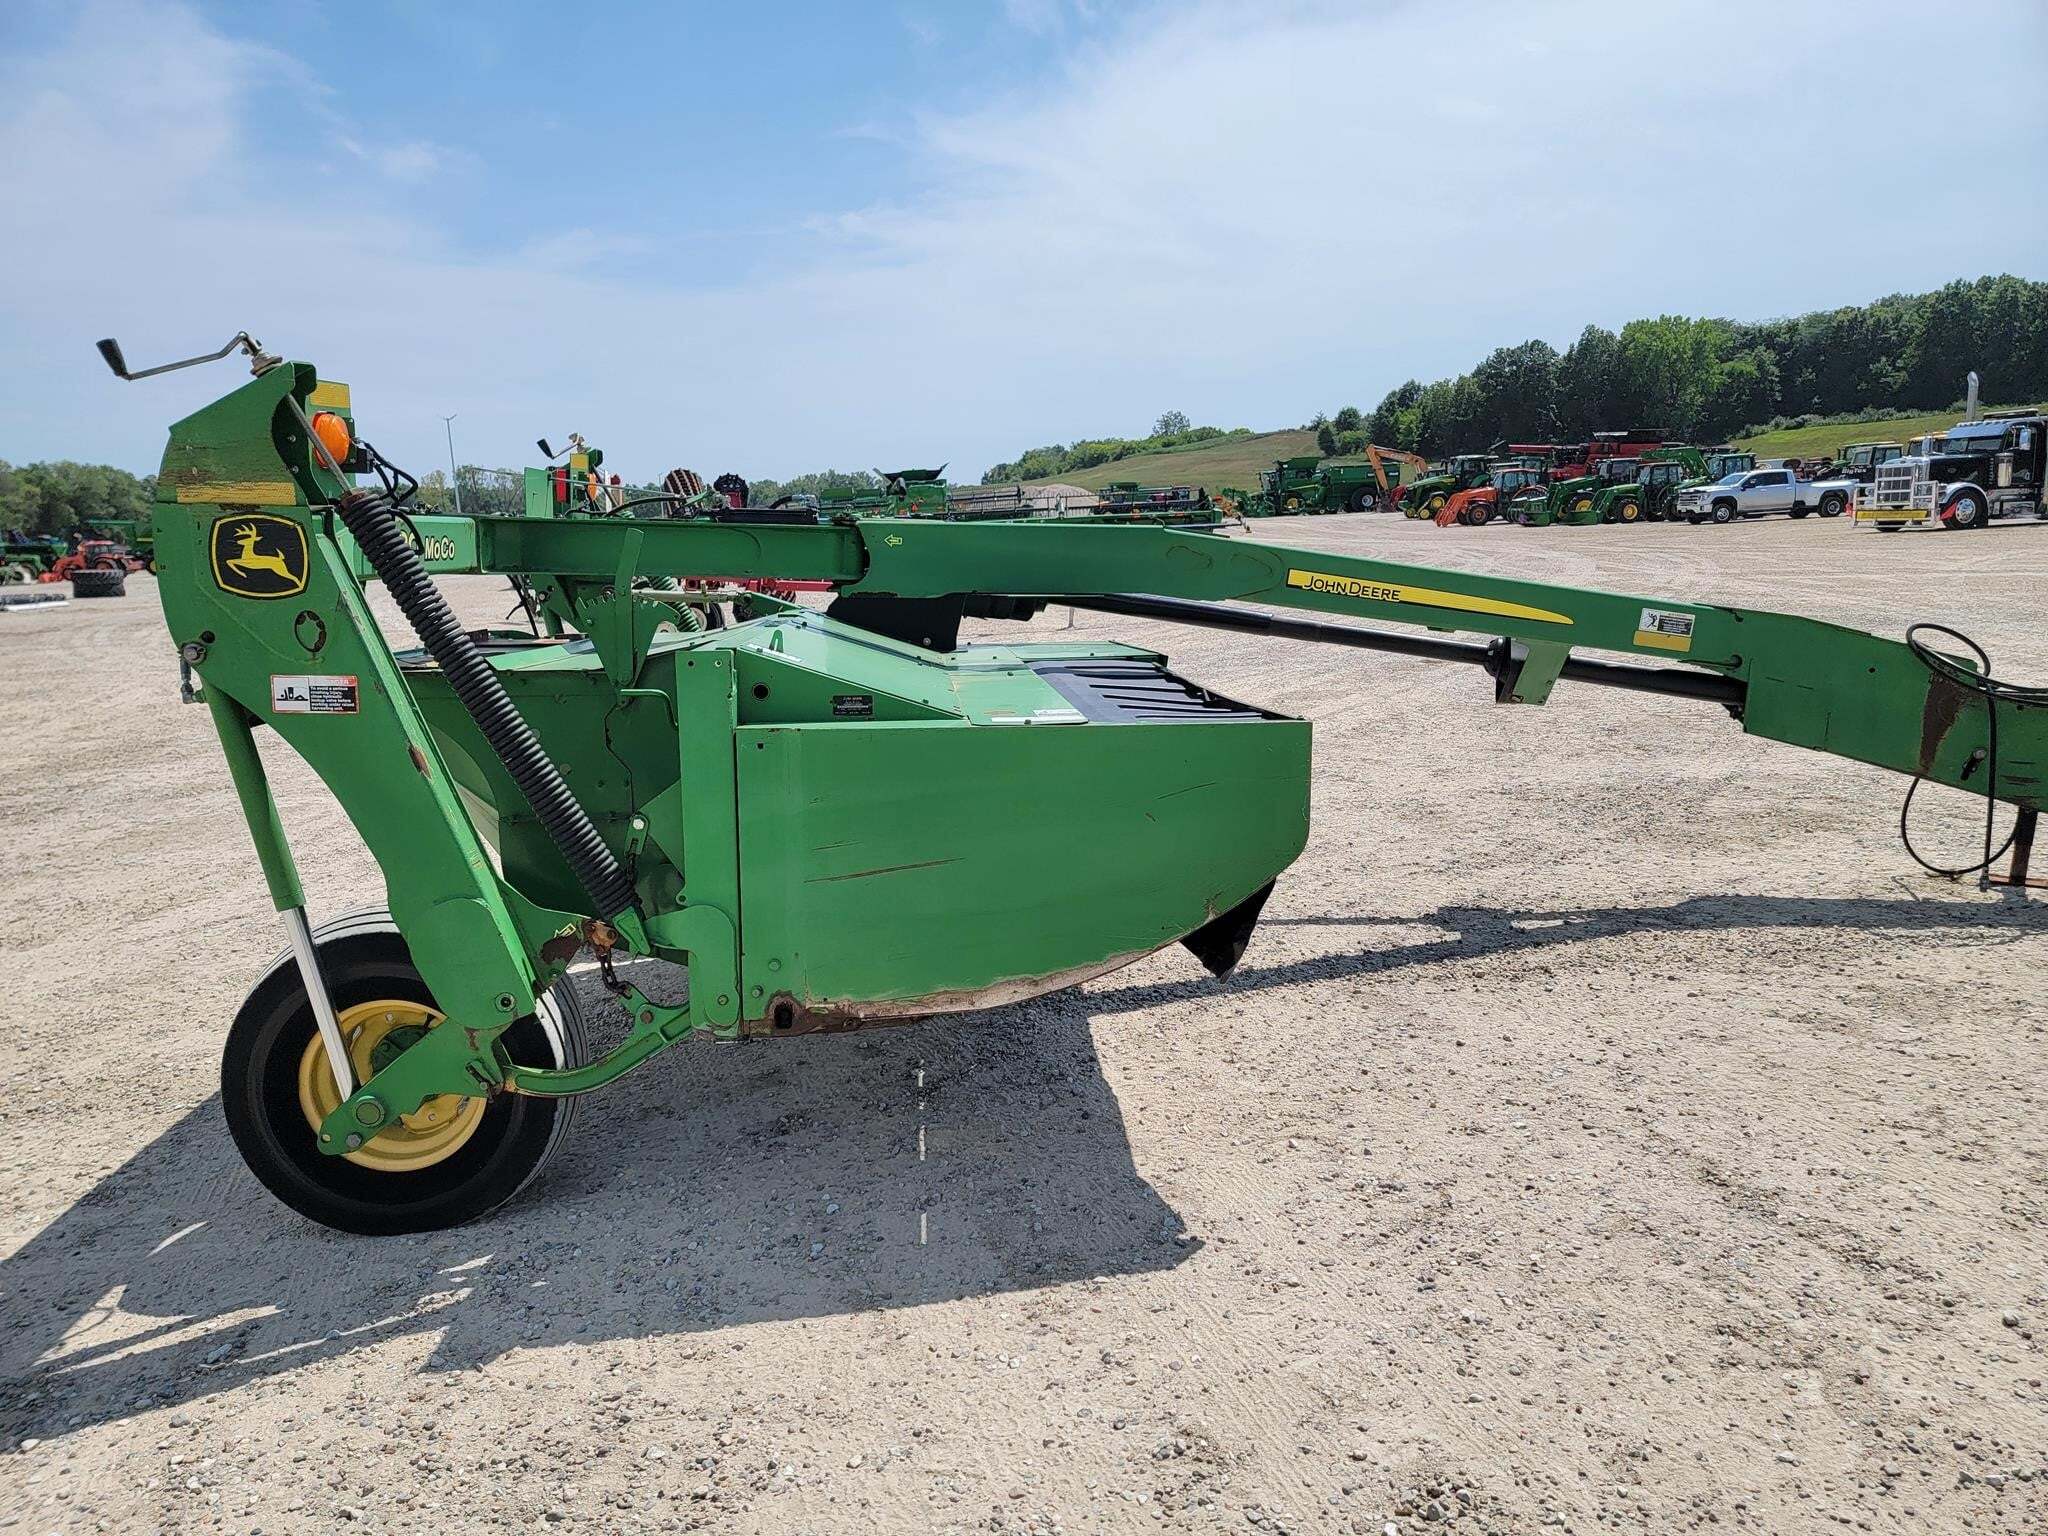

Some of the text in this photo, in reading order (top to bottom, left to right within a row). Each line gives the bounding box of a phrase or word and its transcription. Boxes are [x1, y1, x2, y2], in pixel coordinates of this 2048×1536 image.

[424, 535, 455, 560] MoCo
[1303, 575, 1401, 601] JOHN DEERE
